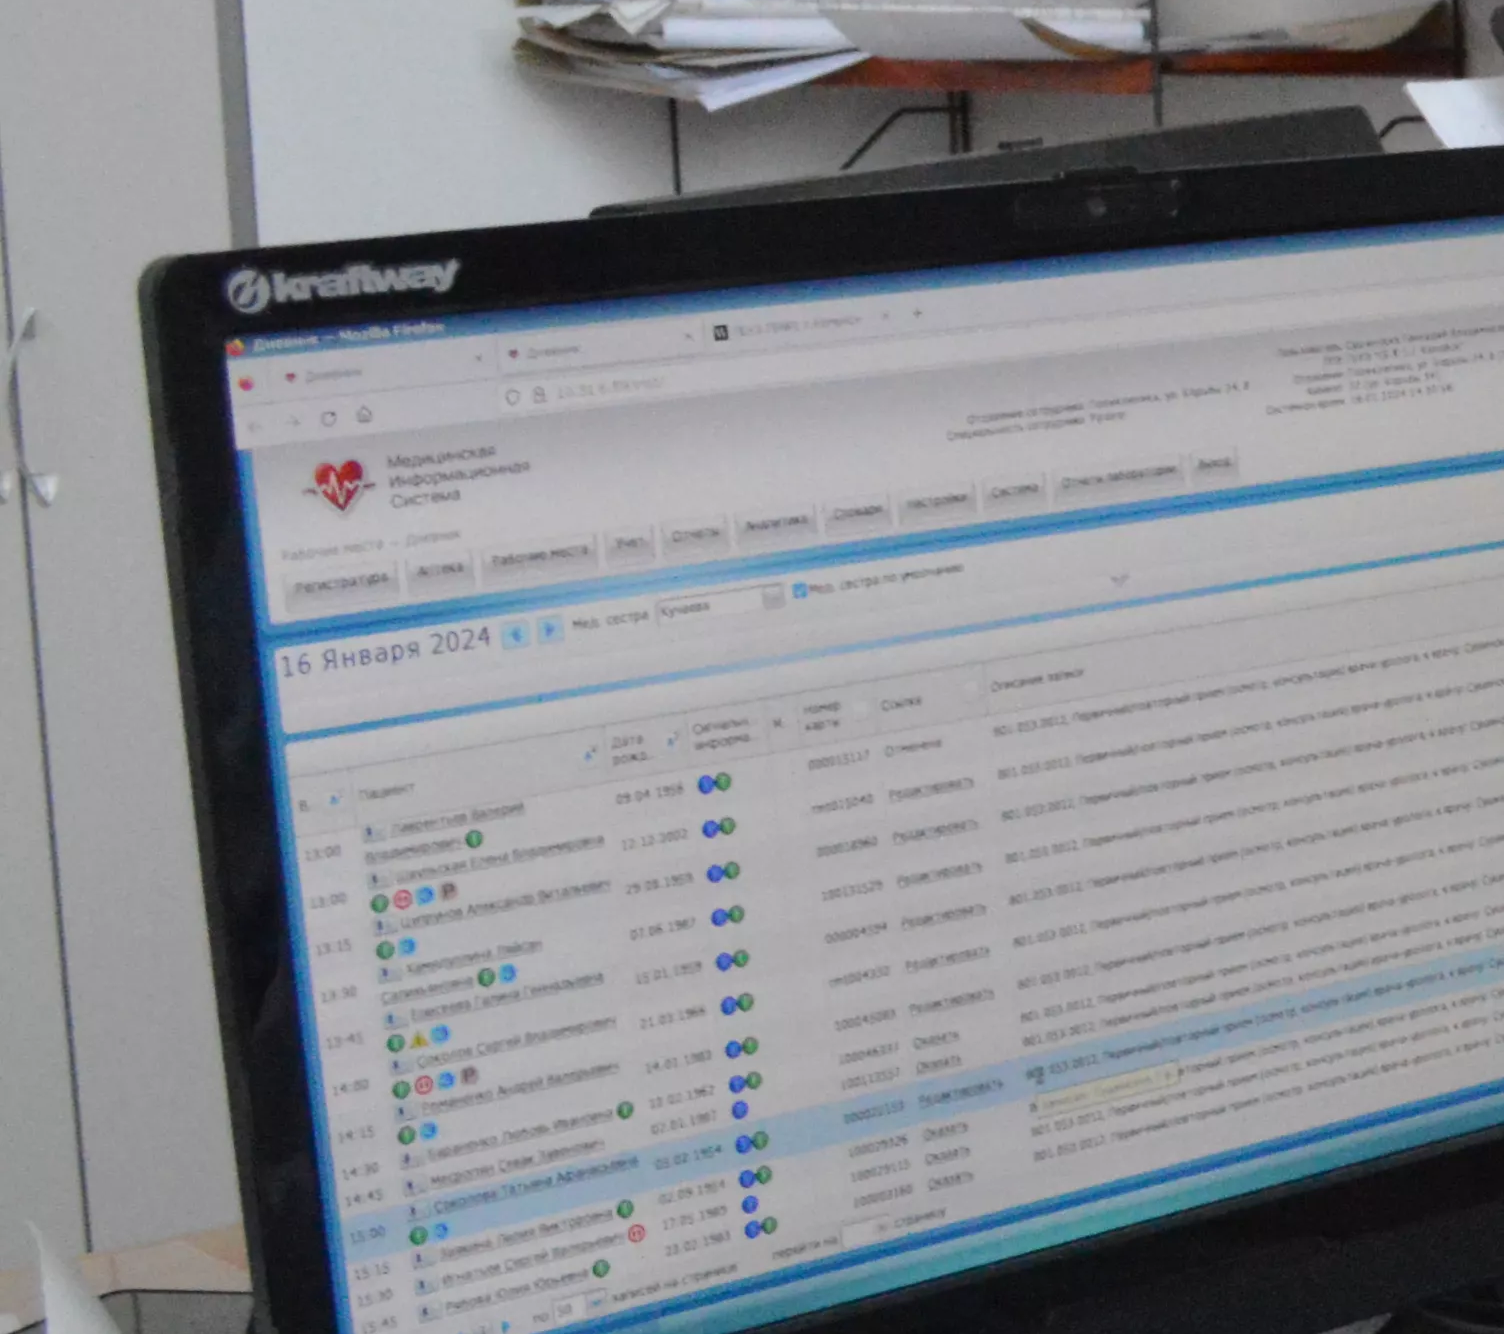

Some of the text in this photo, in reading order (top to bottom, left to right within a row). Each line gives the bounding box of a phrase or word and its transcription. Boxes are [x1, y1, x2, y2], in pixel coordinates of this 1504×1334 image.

[272, 258, 460, 303] kraftway
[339, 326, 390, 341] Mozilla
[394, 321, 446, 336] Firefox
[387, 445, 497, 468] Медицинская
[389, 460, 531, 488] Информационная
[391, 488, 461, 509] Система
[744, 513, 809, 532] Аналитика
[416, 562, 465, 578] Аптека
[294, 572, 390, 595] Регистратура
[281, 626, 492, 678] 16 Января 2024
[358, 782, 416, 801] Пациент
[315, 938, 353, 958] 13:15
[337, 1125, 376, 1144] 14:15
[345, 1189, 384, 1208] 14:45
[354, 1262, 392, 1280] 15:15
